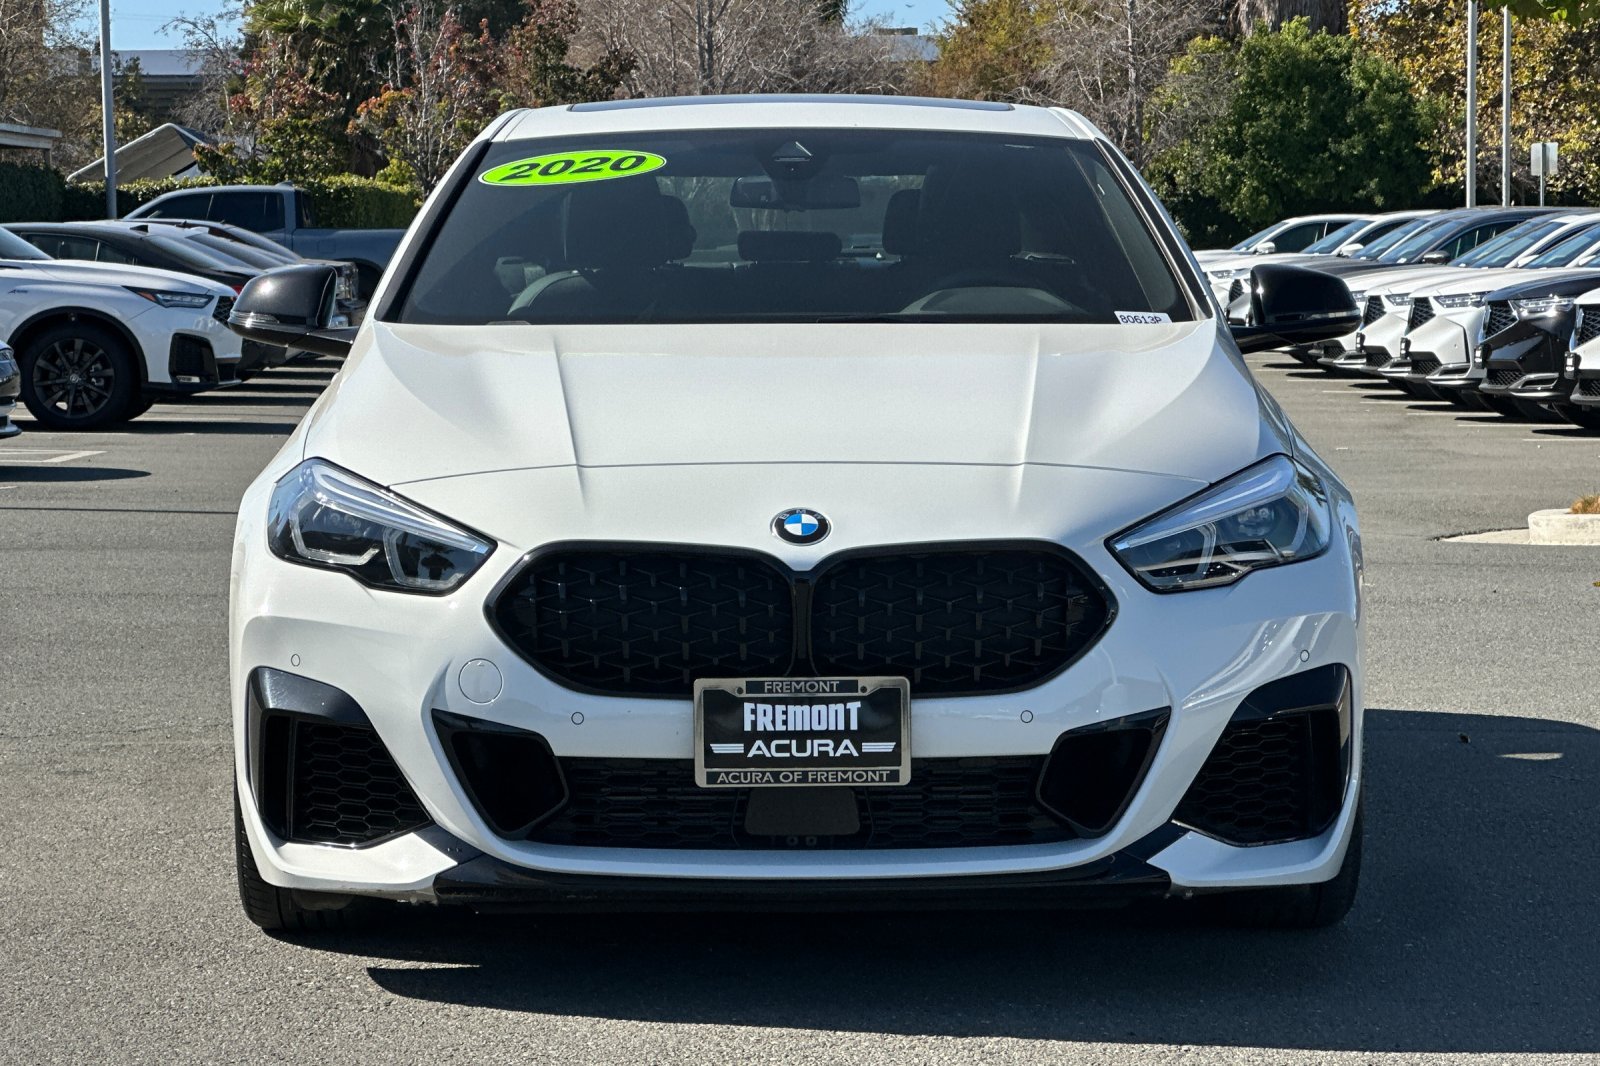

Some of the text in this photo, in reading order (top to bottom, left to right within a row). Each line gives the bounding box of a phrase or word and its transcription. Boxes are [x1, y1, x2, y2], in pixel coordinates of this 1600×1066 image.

[498, 155, 647, 182] 2020
[764, 681, 840, 693] FREMONT
[747, 739, 859, 758] ACURA
[717, 770, 890, 784] ACURA OF FREMONT
